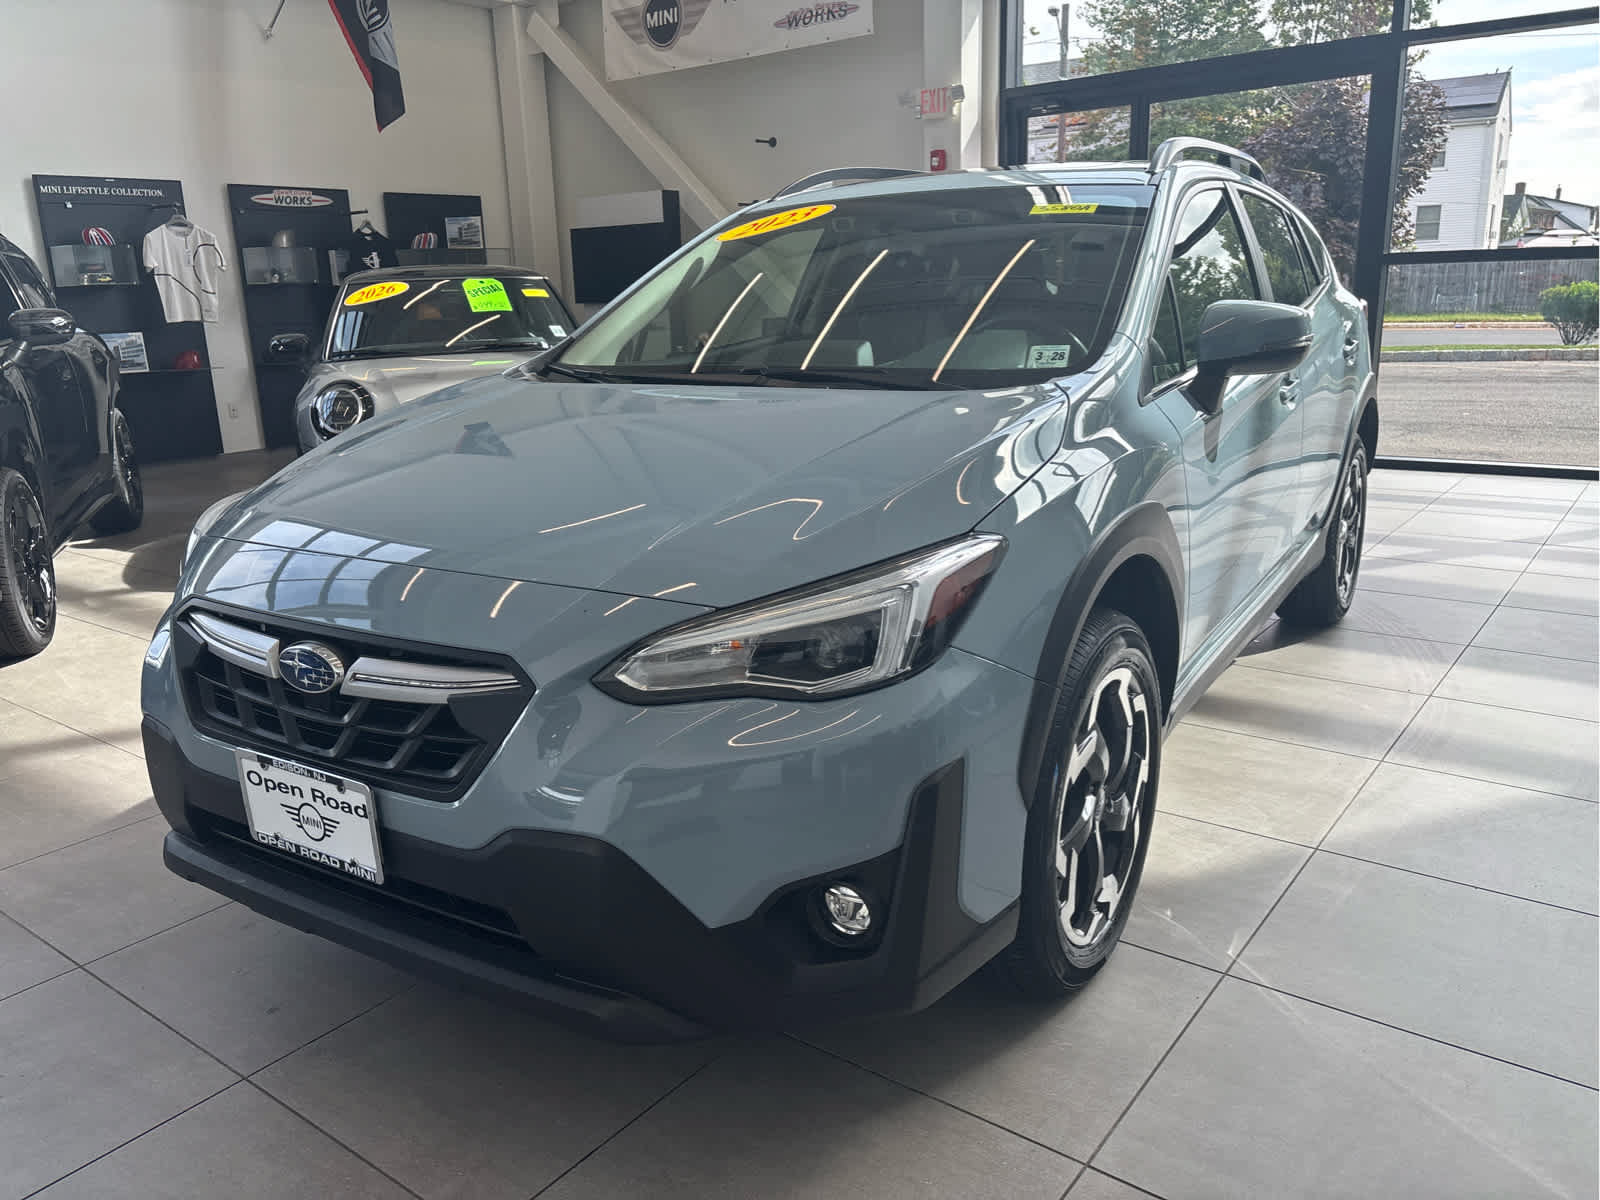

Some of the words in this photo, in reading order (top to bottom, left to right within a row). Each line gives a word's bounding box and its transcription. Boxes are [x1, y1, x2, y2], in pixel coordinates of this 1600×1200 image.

[646, 7, 679, 29] MINI
[787, 3, 849, 29] WORKS
[920, 87, 947, 114] EXIT
[40, 185, 61, 194] MINI
[63, 186, 110, 195] LIFESTYLE
[273, 195, 312, 205] WORKS
[733, 207, 818, 237] 2023
[356, 284, 396, 302] 2026
[467, 283, 503, 298] SPECIAL
[1035, 351, 1043, 361] 3
[1050, 351, 1066, 361] 28
[313, 771, 327, 782] NJ
[246, 770, 304, 799] Open
[310, 787, 369, 820] Road
[301, 815, 323, 830] MINI
[258, 833, 296, 853] OPEN
[300, 848, 341, 868] ROAD
[344, 862, 376, 882] MINI
